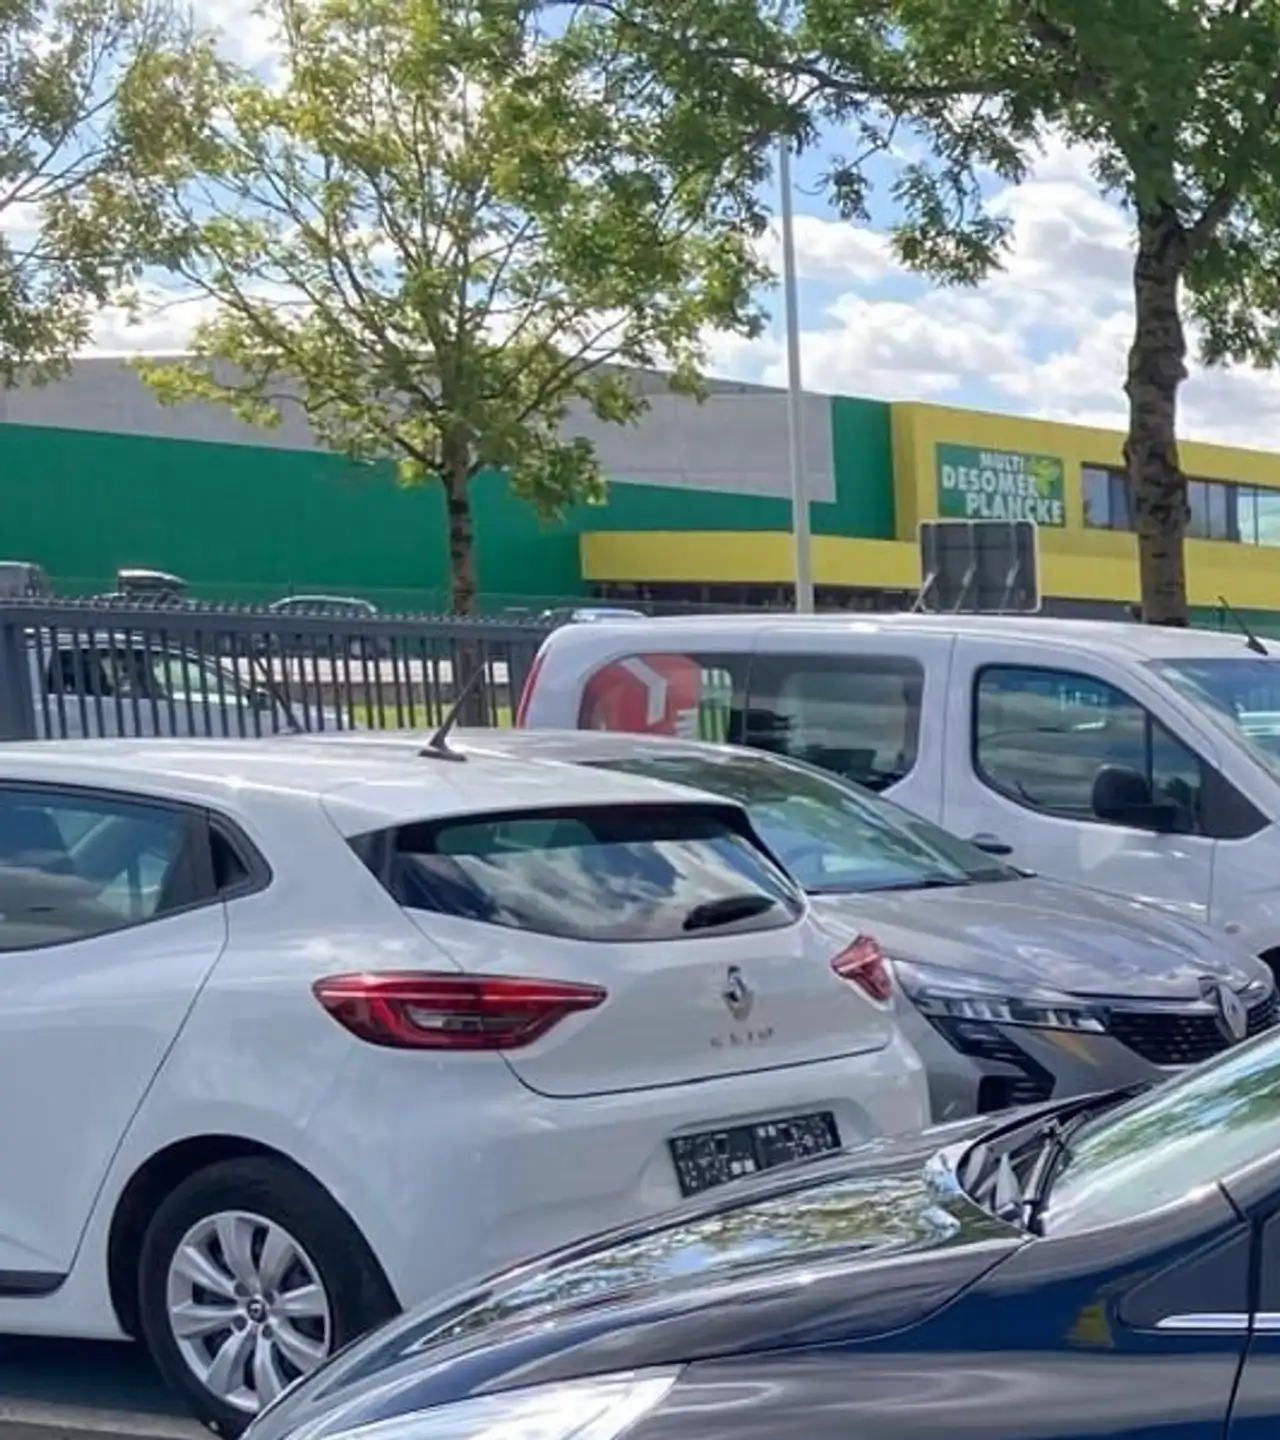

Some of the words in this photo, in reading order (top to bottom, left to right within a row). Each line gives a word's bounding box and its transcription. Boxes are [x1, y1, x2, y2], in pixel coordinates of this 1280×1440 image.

[980, 451, 1025, 472] MULTI
[941, 464, 1039, 498] DESOMER
[964, 492, 1063, 524] PLANCKE
